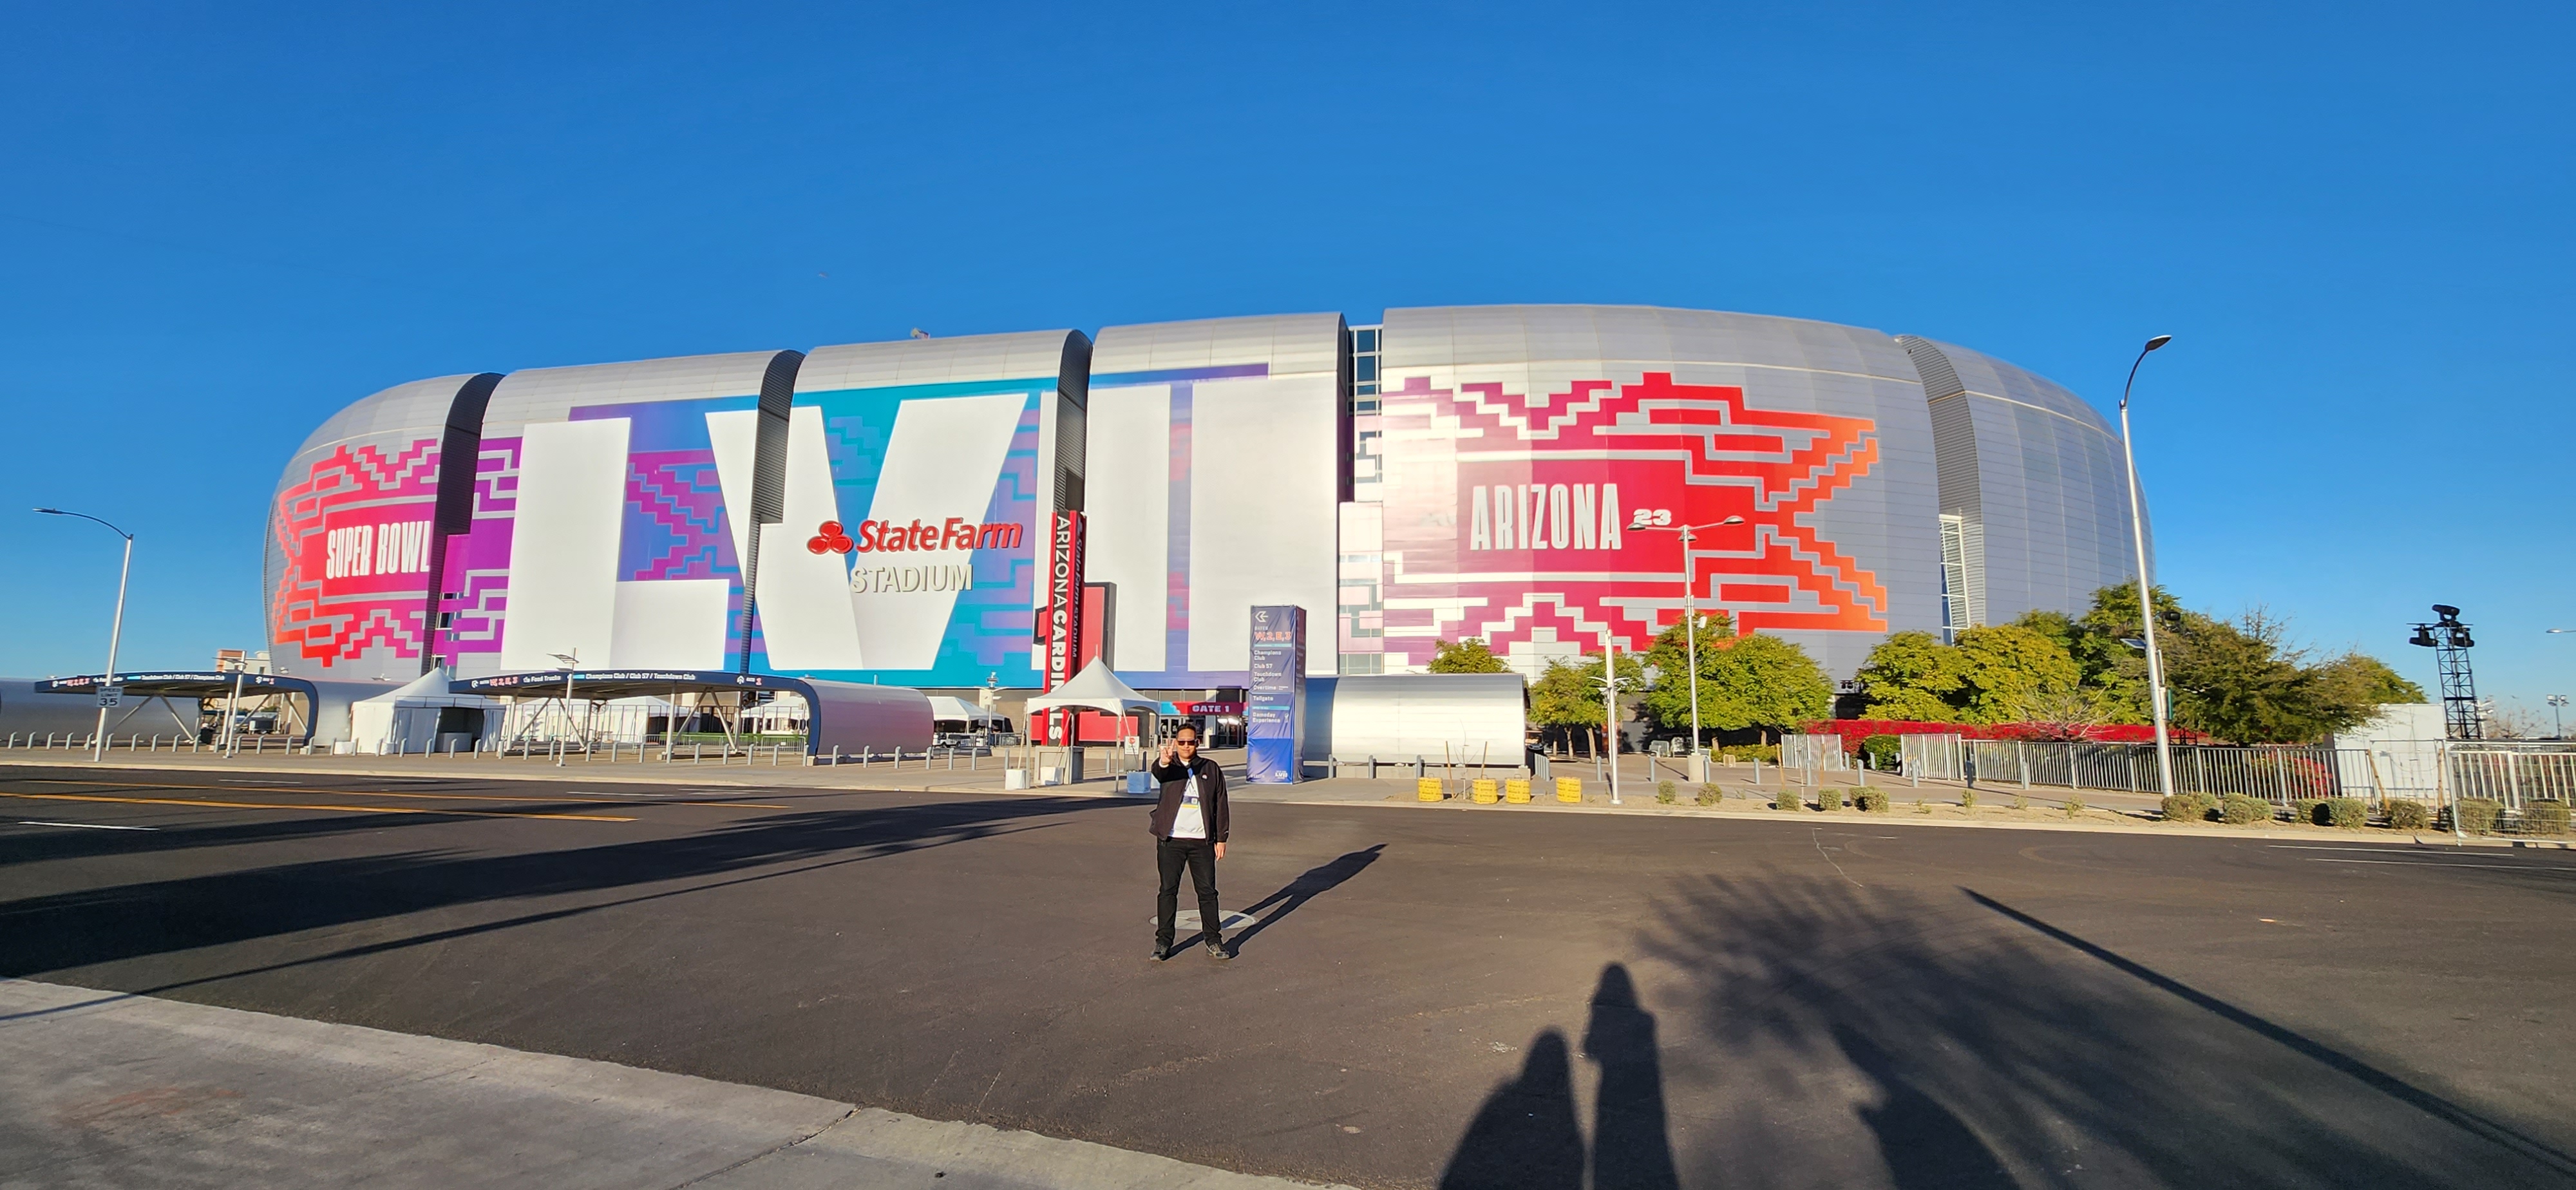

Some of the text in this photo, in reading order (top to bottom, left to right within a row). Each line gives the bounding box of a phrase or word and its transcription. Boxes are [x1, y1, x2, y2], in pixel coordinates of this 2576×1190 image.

[1470, 483, 1622, 550] ARIZONA
[1633, 509, 1672, 525] 23
[326, 520, 431, 579] SUPER BOWL
[849, 563, 973, 593] STADIUM
[1048, 516, 1072, 740] ARIZONA CARDINLS
[99, 697, 118, 706] 35
